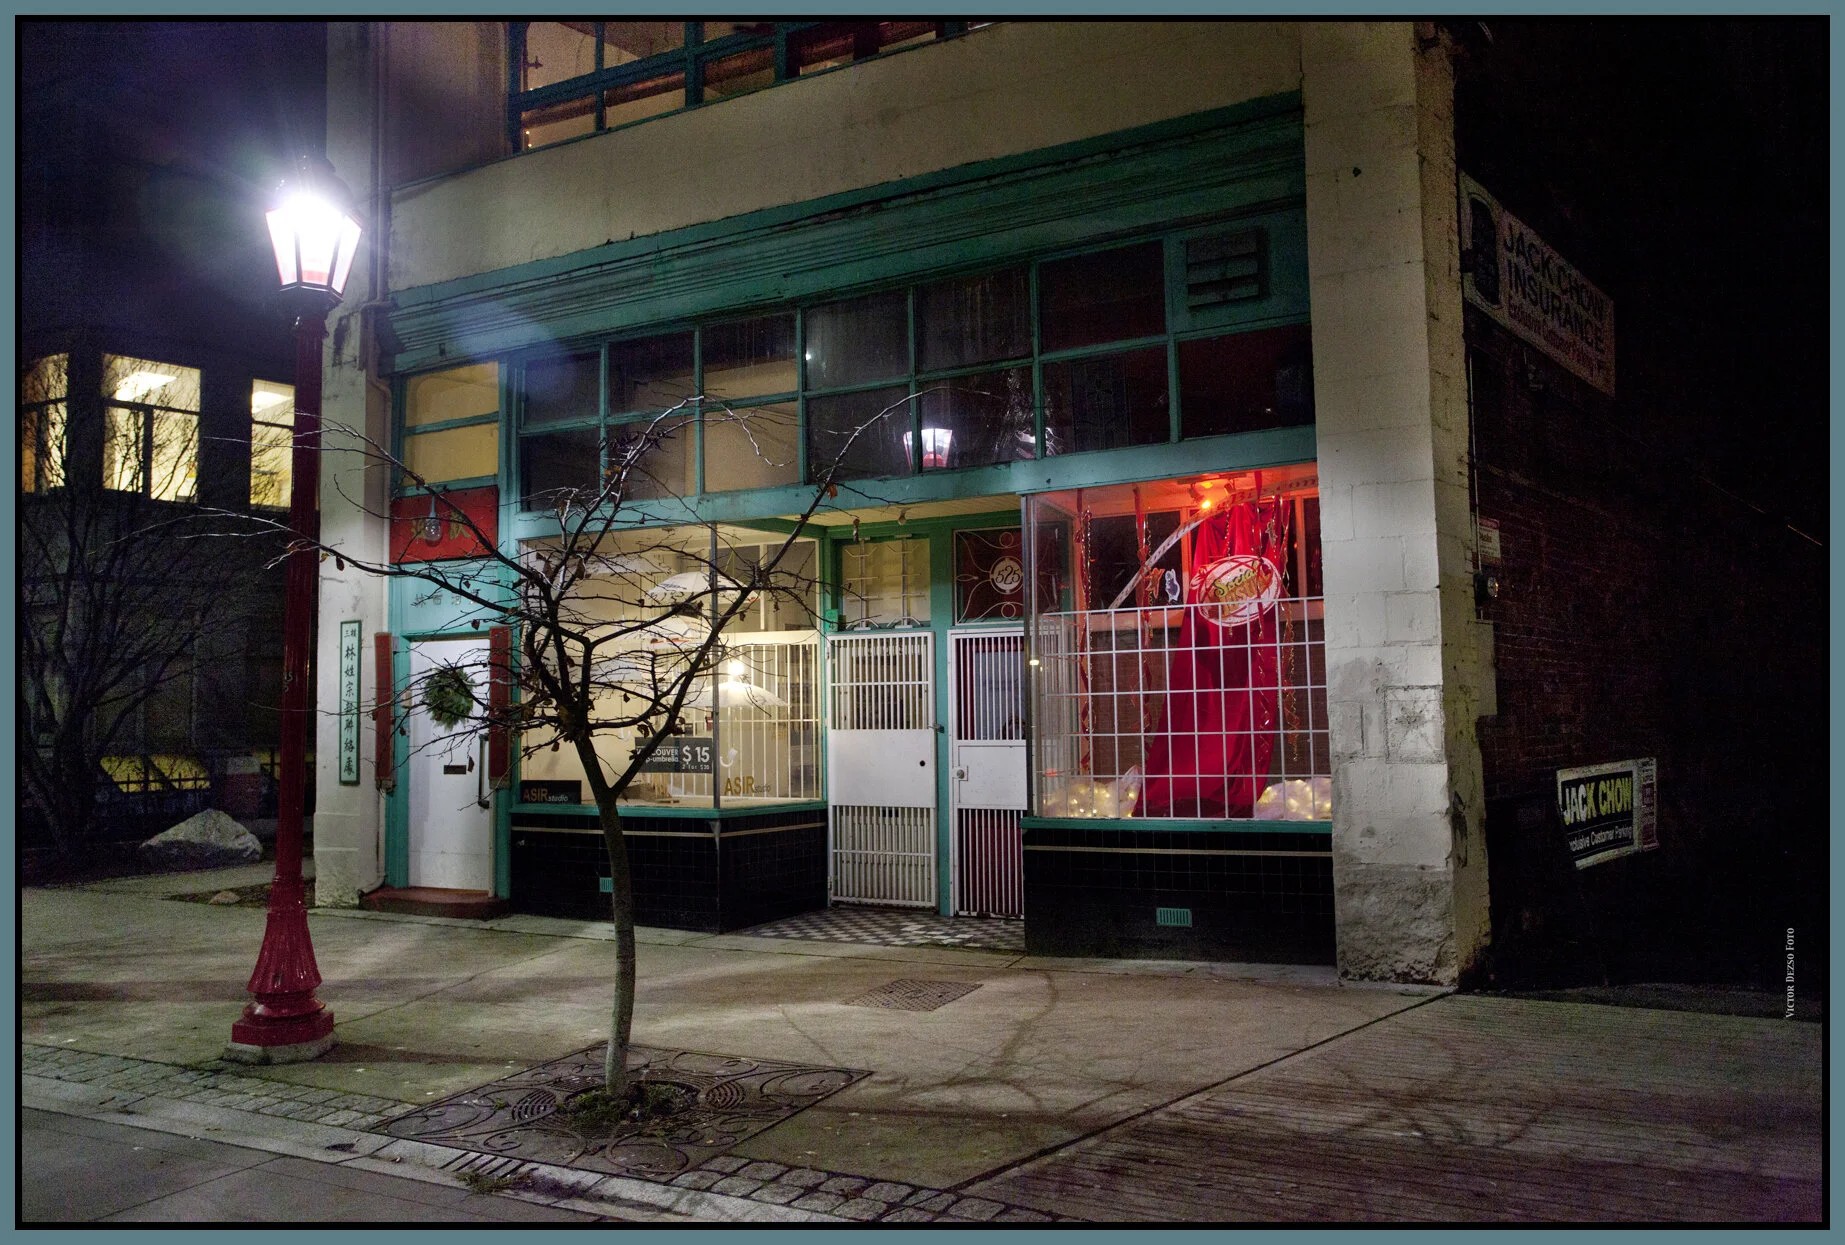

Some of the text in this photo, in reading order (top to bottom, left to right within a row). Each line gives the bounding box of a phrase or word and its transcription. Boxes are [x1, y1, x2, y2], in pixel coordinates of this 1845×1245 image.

[1503, 221, 1604, 321] JACK CHOW
[1507, 259, 1605, 354] INSURANCE
[995, 565, 1022, 585] 525
[1212, 560, 1259, 599] Social
[636, 748, 679, 756] VOUVER
[695, 746, 710, 763] 15
[1562, 782, 1597, 826] JACK
[1598, 776, 1632, 816] CHOW
[1569, 824, 1632, 852] xclusive Customer Parking
